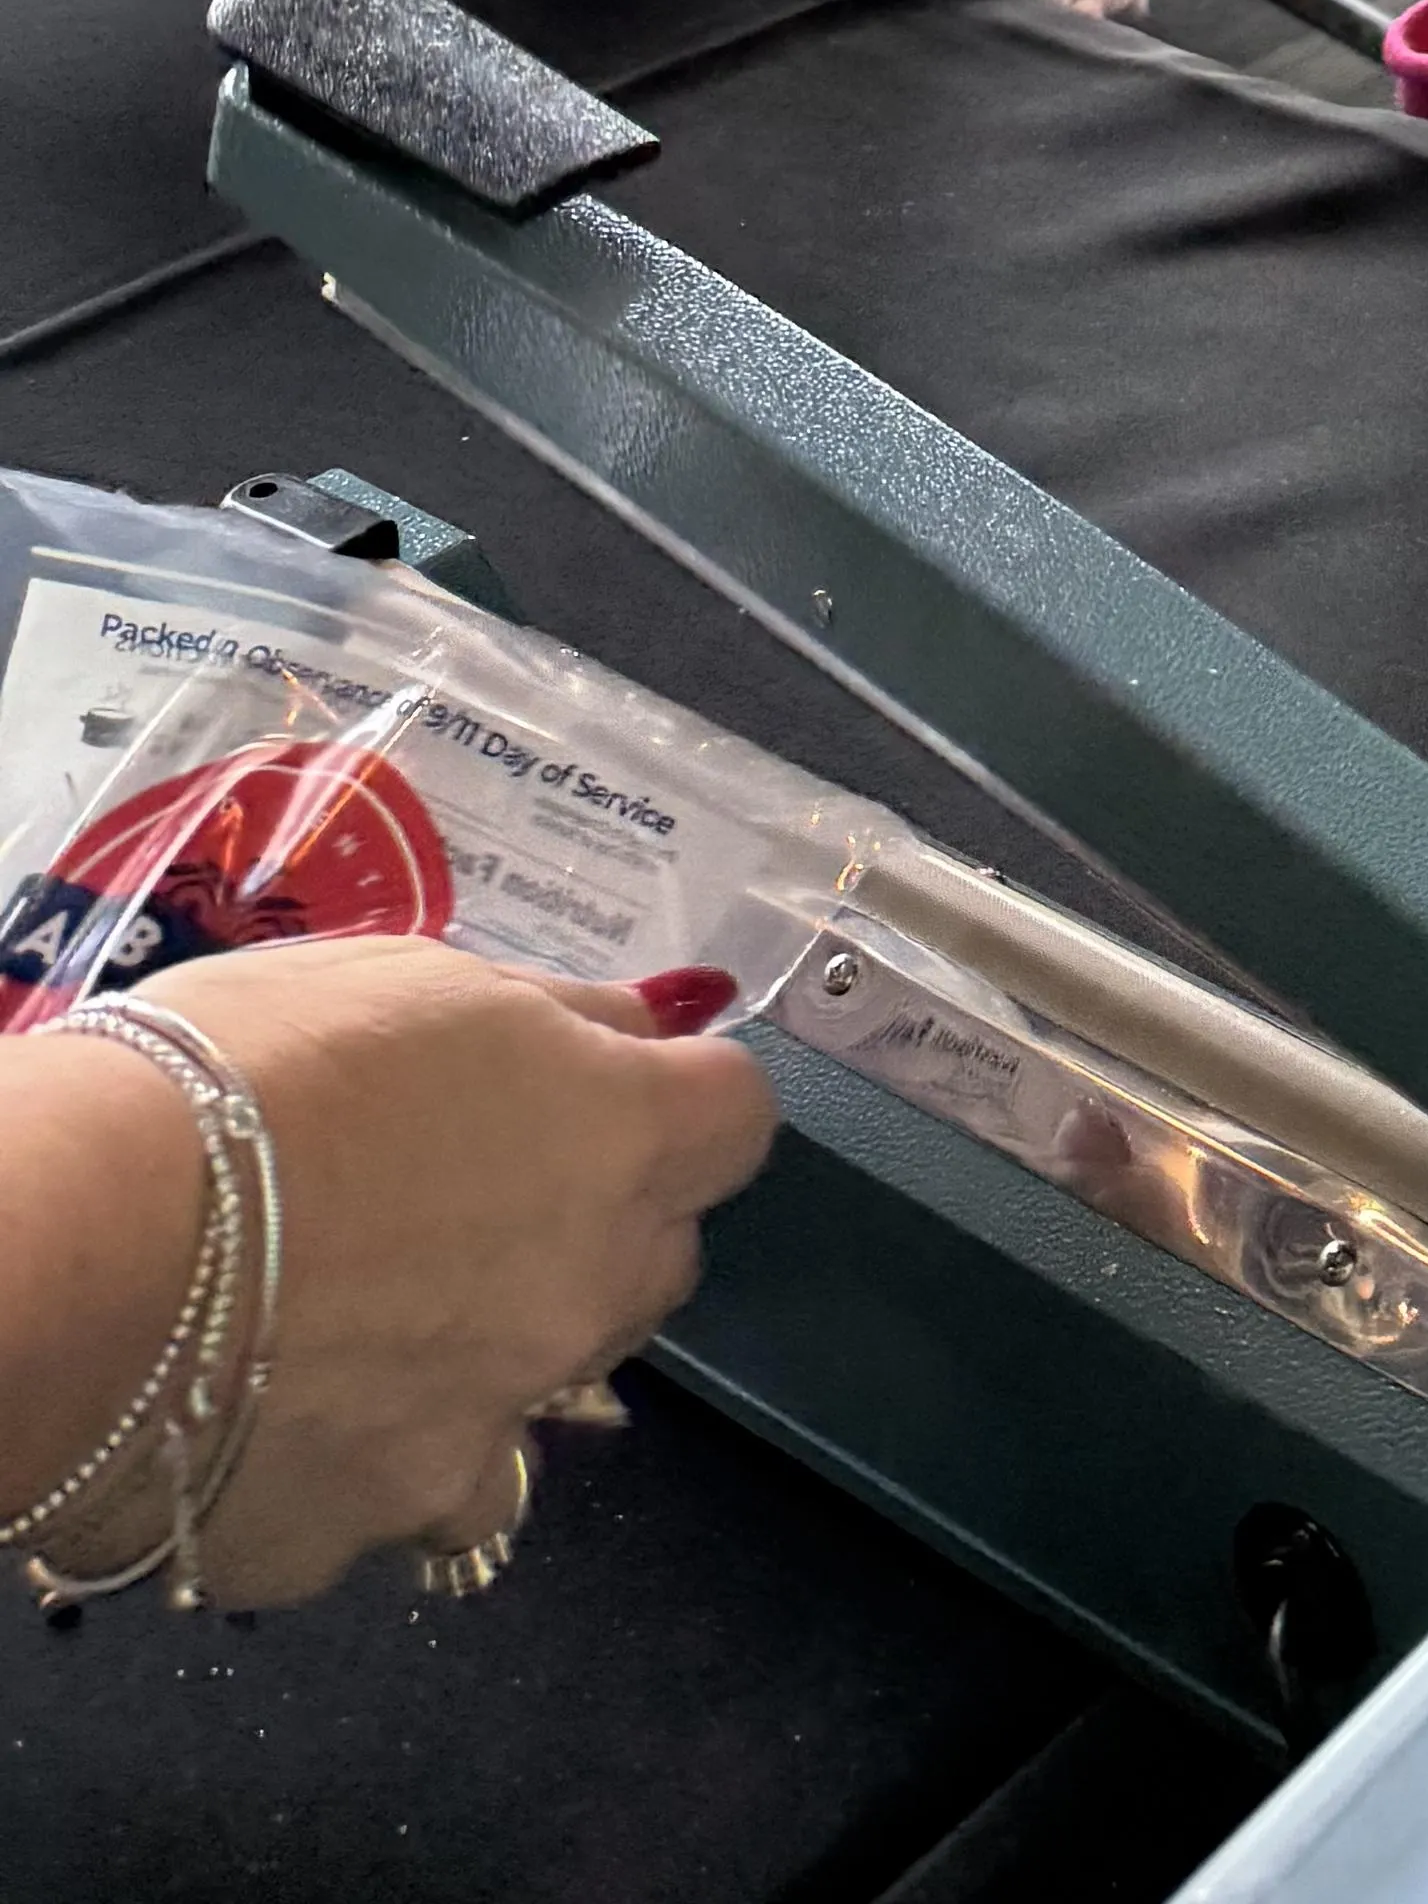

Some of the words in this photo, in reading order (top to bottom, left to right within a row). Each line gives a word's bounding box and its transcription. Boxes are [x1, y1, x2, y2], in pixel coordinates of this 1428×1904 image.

[101, 612, 217, 652] Packed
[481, 732, 538, 778] Day
[540, 763, 579, 787] of
[571, 772, 676, 836] Service
